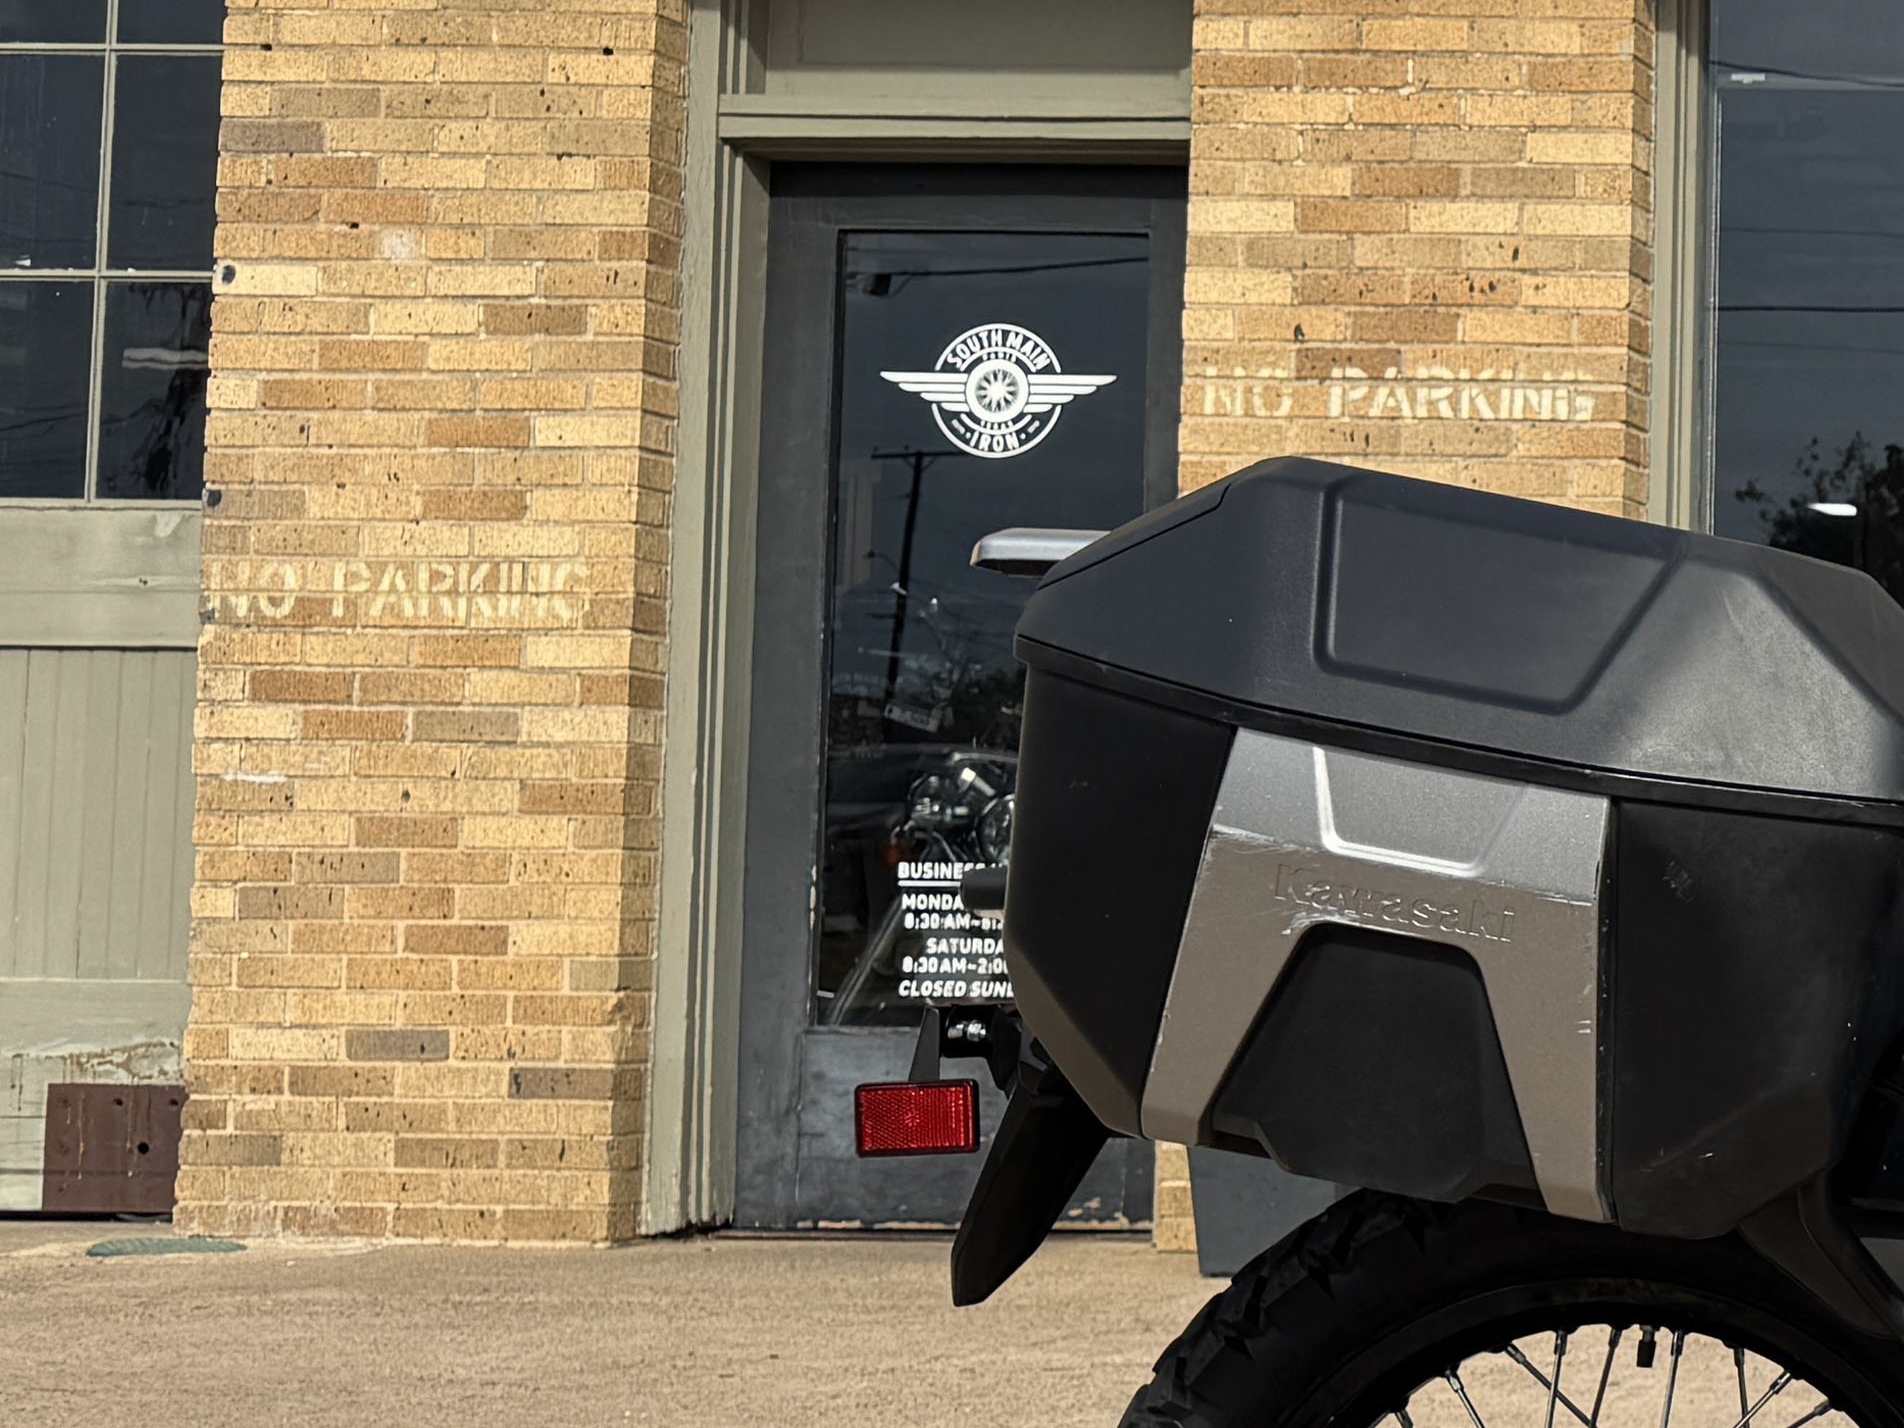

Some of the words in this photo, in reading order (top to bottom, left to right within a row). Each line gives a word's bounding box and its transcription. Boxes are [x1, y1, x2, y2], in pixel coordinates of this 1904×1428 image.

[946, 327, 1002, 370] SOUTH
[1005, 331, 1052, 372] MAIN
[1203, 365, 1293, 418] NO
[1327, 365, 1596, 422] PARKING
[970, 433, 1019, 453] IRON
[206, 560, 303, 619] NO
[332, 560, 591, 623] PARKING
[901, 893, 965, 911] MONDA
[1272, 863, 1517, 944] Kawasaki
[903, 912, 941, 930] 8:30
[926, 937, 1005, 955] SATURDA
[902, 956, 938, 974] 8:30
[898, 980, 967, 999] CLOSED
